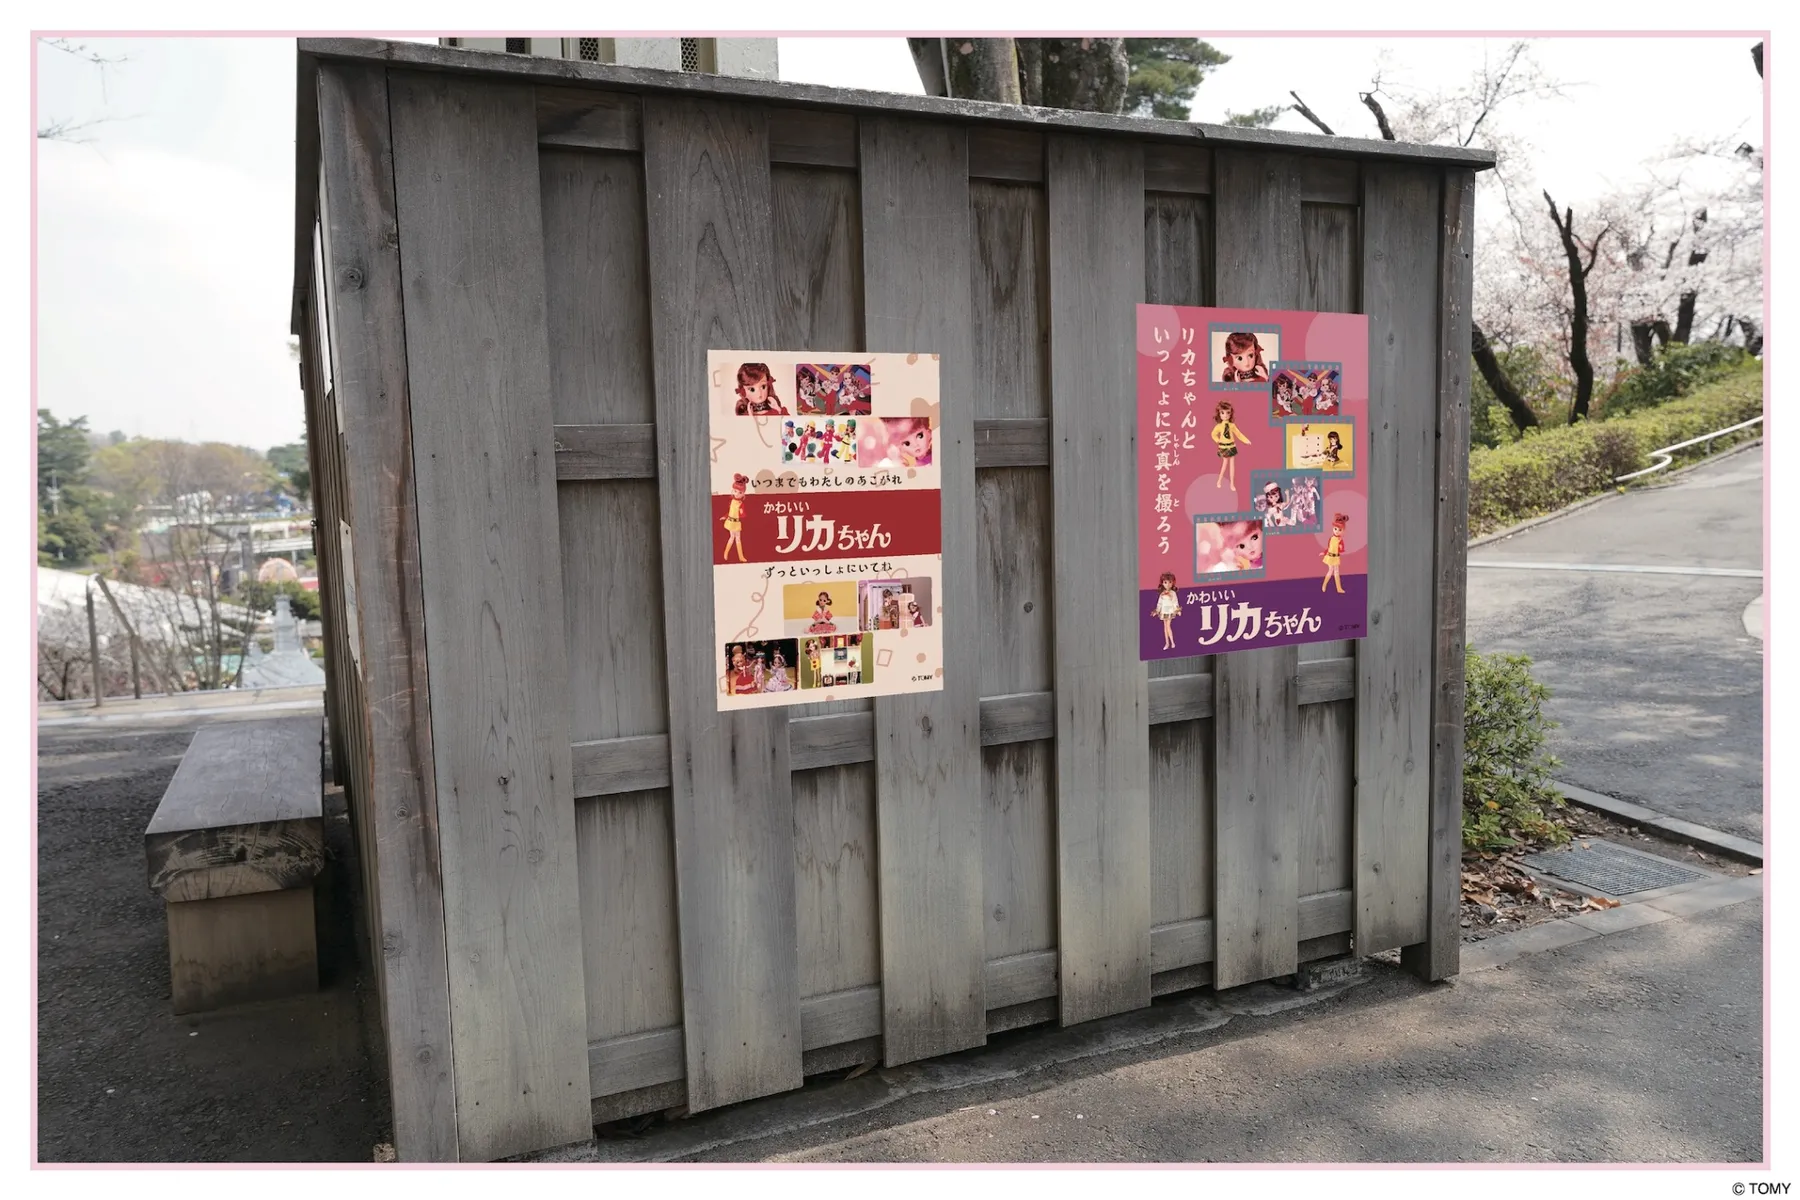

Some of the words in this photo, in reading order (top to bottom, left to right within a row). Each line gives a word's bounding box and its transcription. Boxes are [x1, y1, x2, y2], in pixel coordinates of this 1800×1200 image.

[1180, 327, 1197, 450] リカちゃんと
[1153, 326, 1173, 555] いっしょに写真を撮ろう
[1172, 433, 1180, 467] しゃしん
[751, 474, 902, 489] いつまでもわたしのあこがれ
[763, 501, 810, 514] かわいい
[775, 514, 892, 553] リカちゃん
[765, 561, 893, 578] ずっといっしょにいてね
[1186, 589, 1236, 605] かわいい
[1198, 601, 1322, 646] リカちゃん
